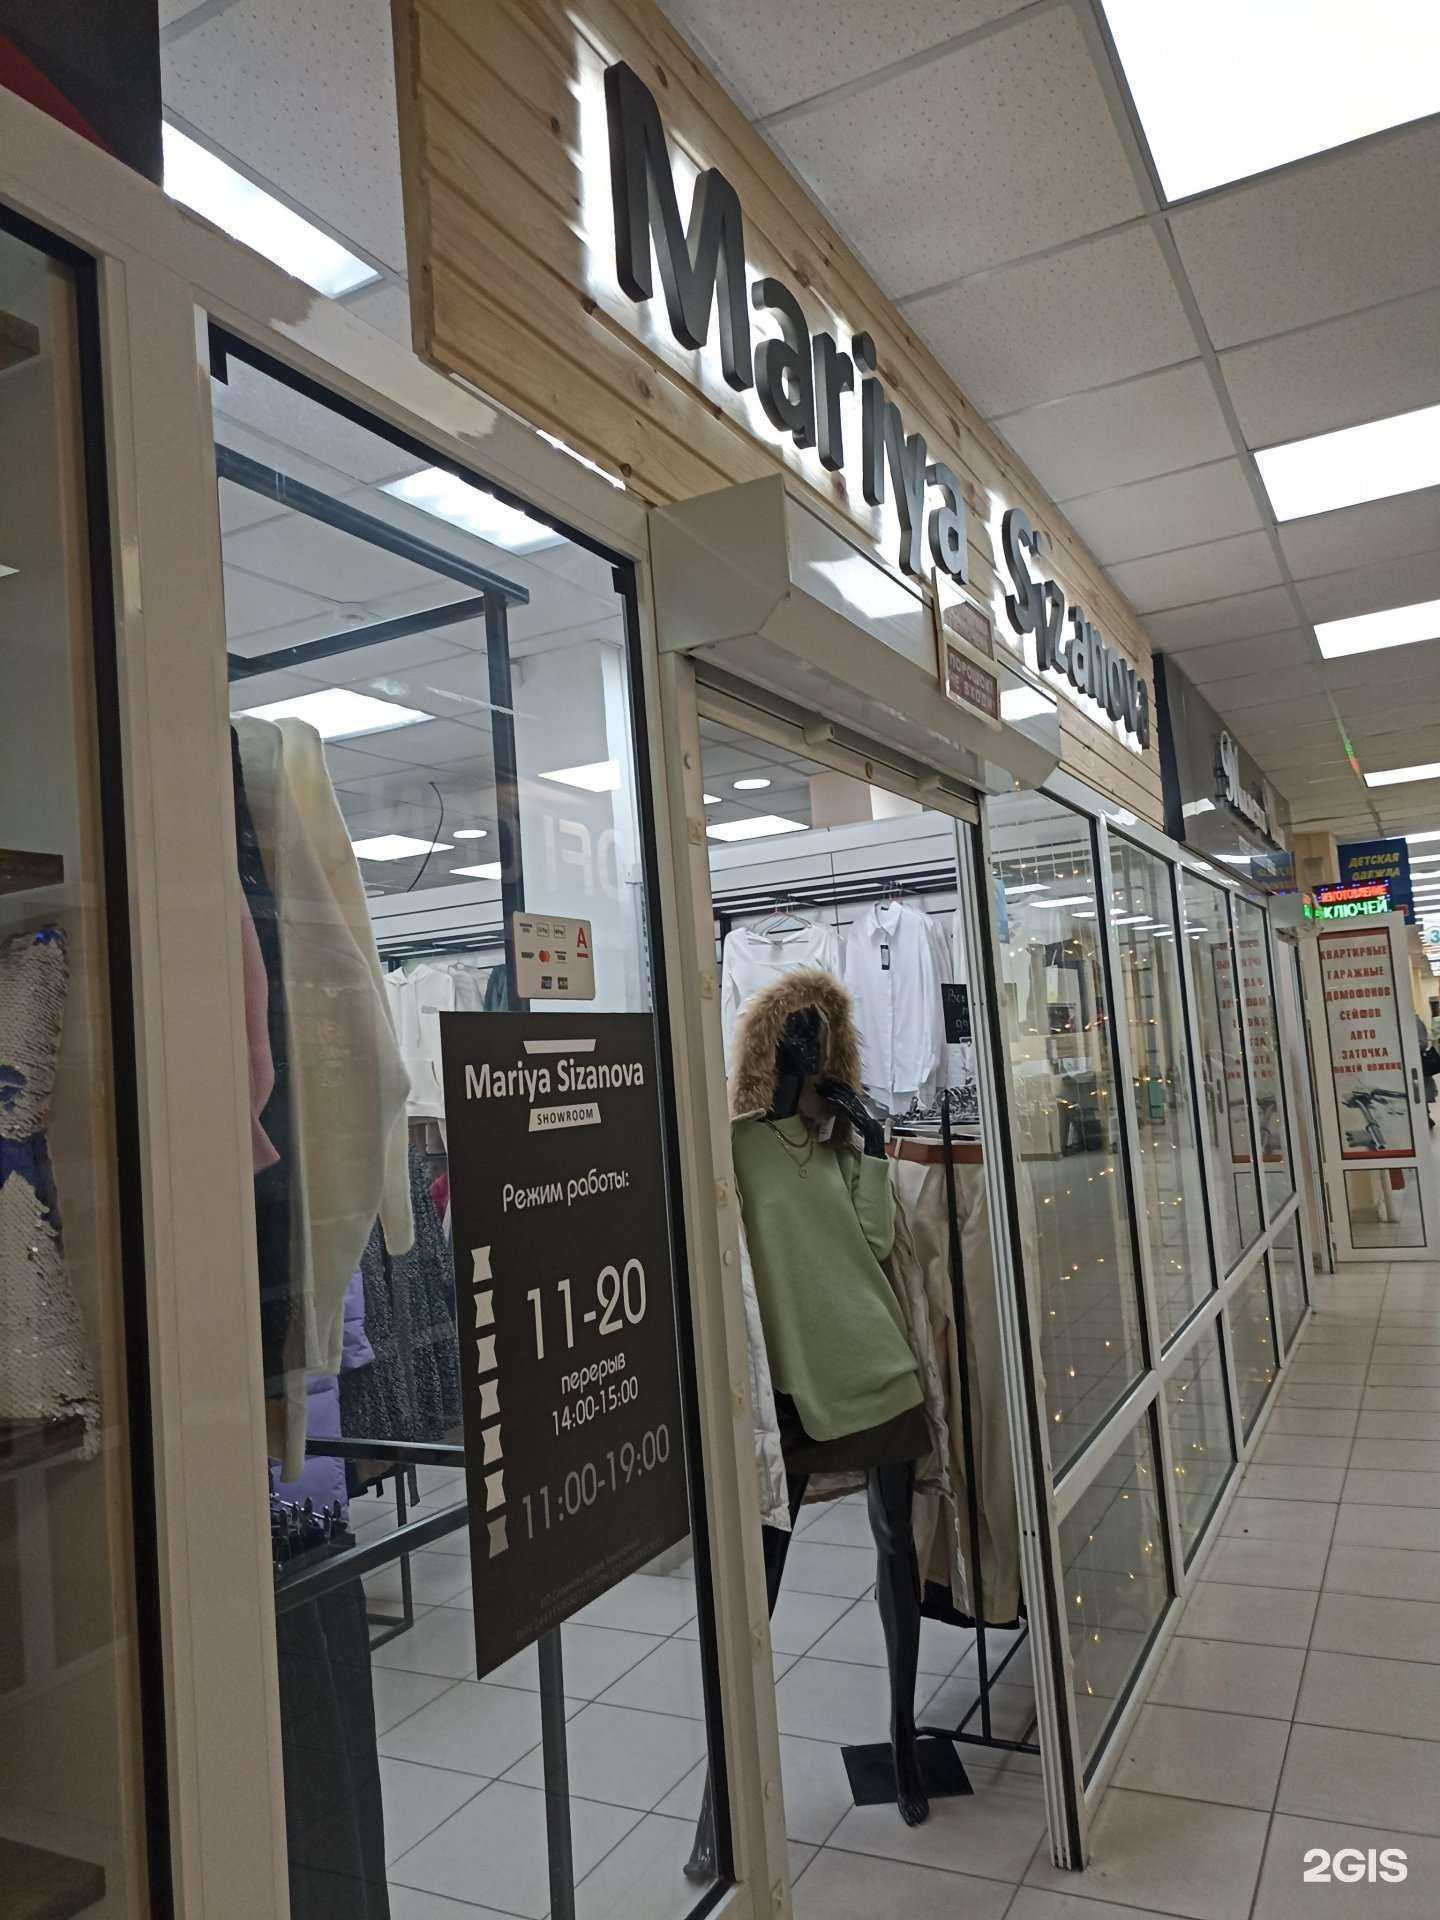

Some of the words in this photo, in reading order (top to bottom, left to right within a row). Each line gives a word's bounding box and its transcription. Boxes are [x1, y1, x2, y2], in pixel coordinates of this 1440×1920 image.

[604, 59, 970, 586] Mariya
[1000, 506, 1150, 750] Sizanova
[1323, 896, 1388, 919] КЛЮЧЕЙ
[1320, 945, 1387, 961] КВАРТИРНЫЕ
[1327, 966, 1384, 980] ГАРАЖНЫЕ
[1325, 987, 1391, 1002] ДОМОФОНОВ
[1340, 1008, 1381, 1021] СЕЙФОВ
[1351, 1029, 1376, 1041] АВТО
[1342, 1047, 1389, 1060] ЗАТОЧКА
[465, 1060, 551, 1103] Mariya
[557, 1058, 645, 1093] Sizanova
[537, 1108, 594, 1126] SHOWROOM
[502, 1181, 563, 1213] Режим
[567, 1168, 630, 1207] работы:
[527, 1257, 647, 1360] 11-20
[561, 1352, 626, 1395] перерыв
[552, 1375, 639, 1437] 14:00-15:00
[522, 1424, 670, 1540] 11:00-19:00
